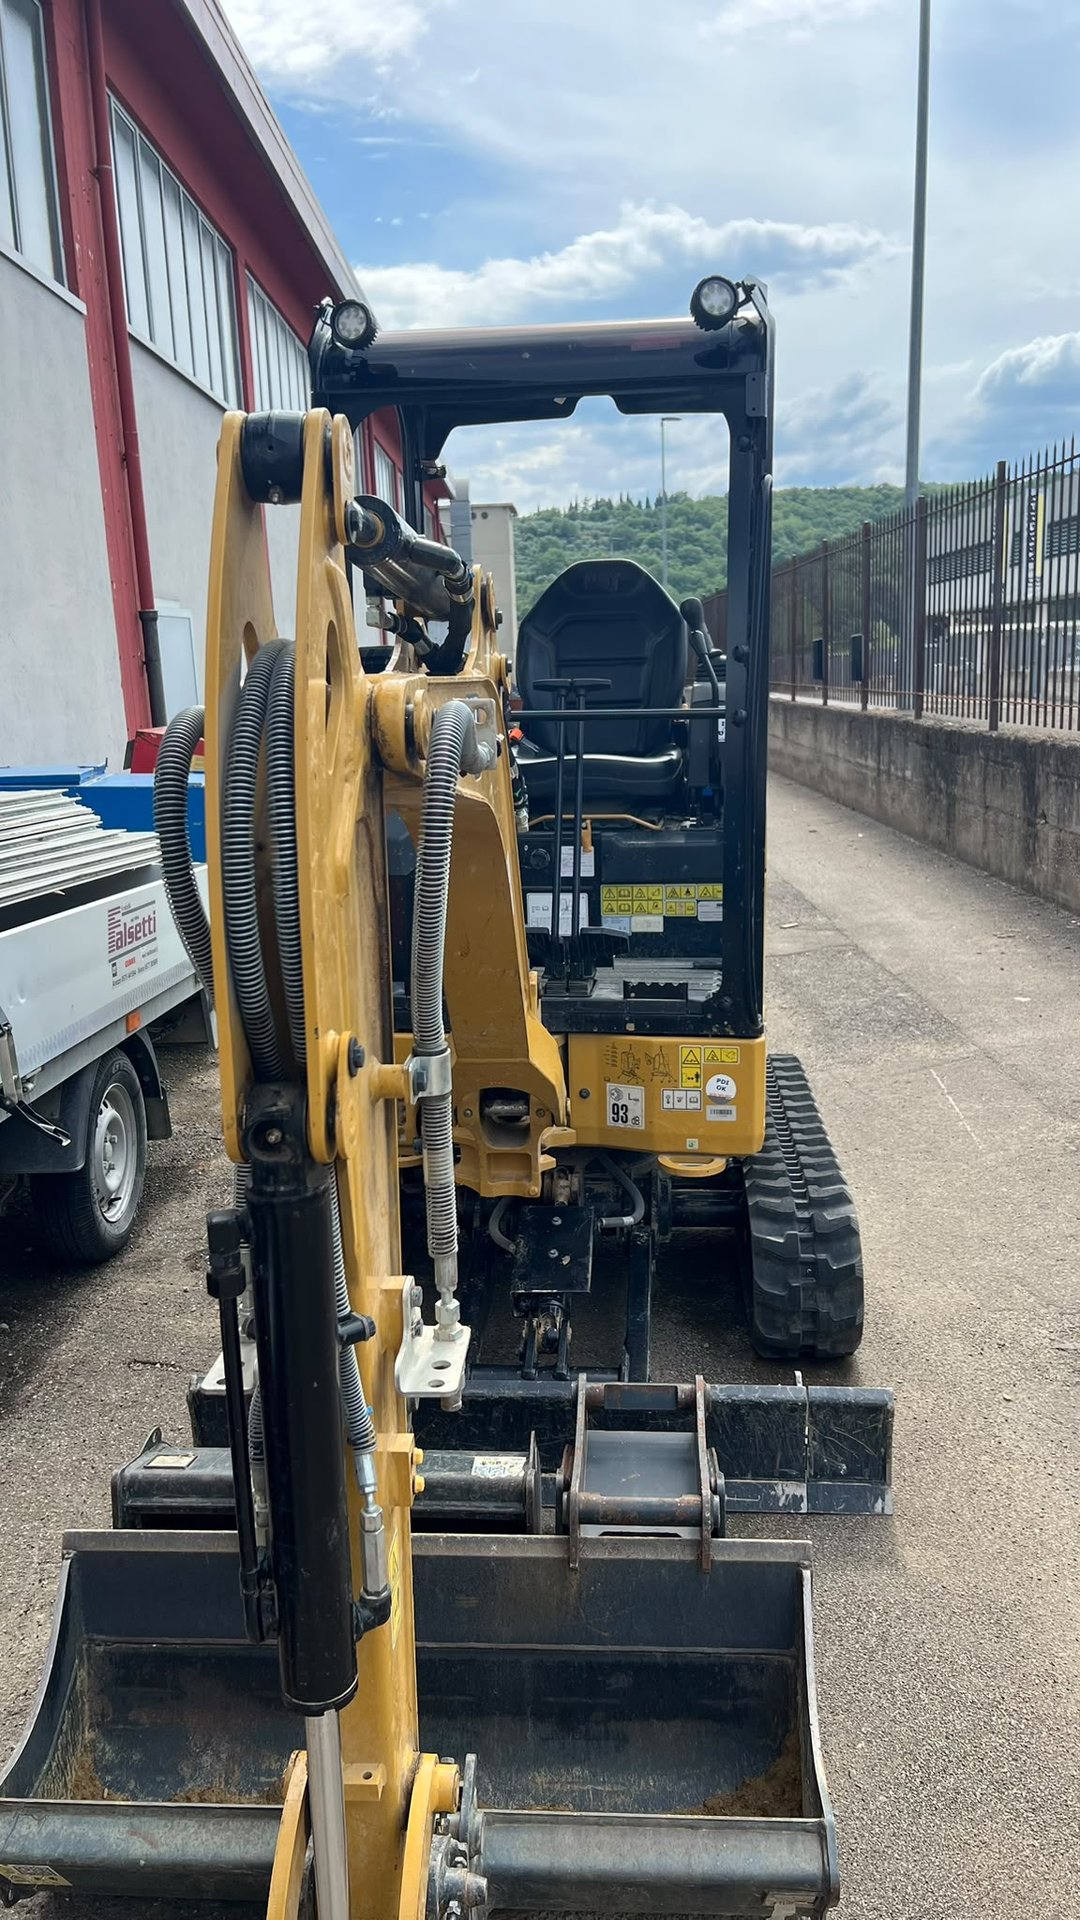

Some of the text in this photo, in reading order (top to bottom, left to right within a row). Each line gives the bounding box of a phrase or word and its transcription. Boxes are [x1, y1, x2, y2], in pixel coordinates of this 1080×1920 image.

[716, 1078, 730, 1086] PDI
[612, 1103, 640, 1126] 93 dB
